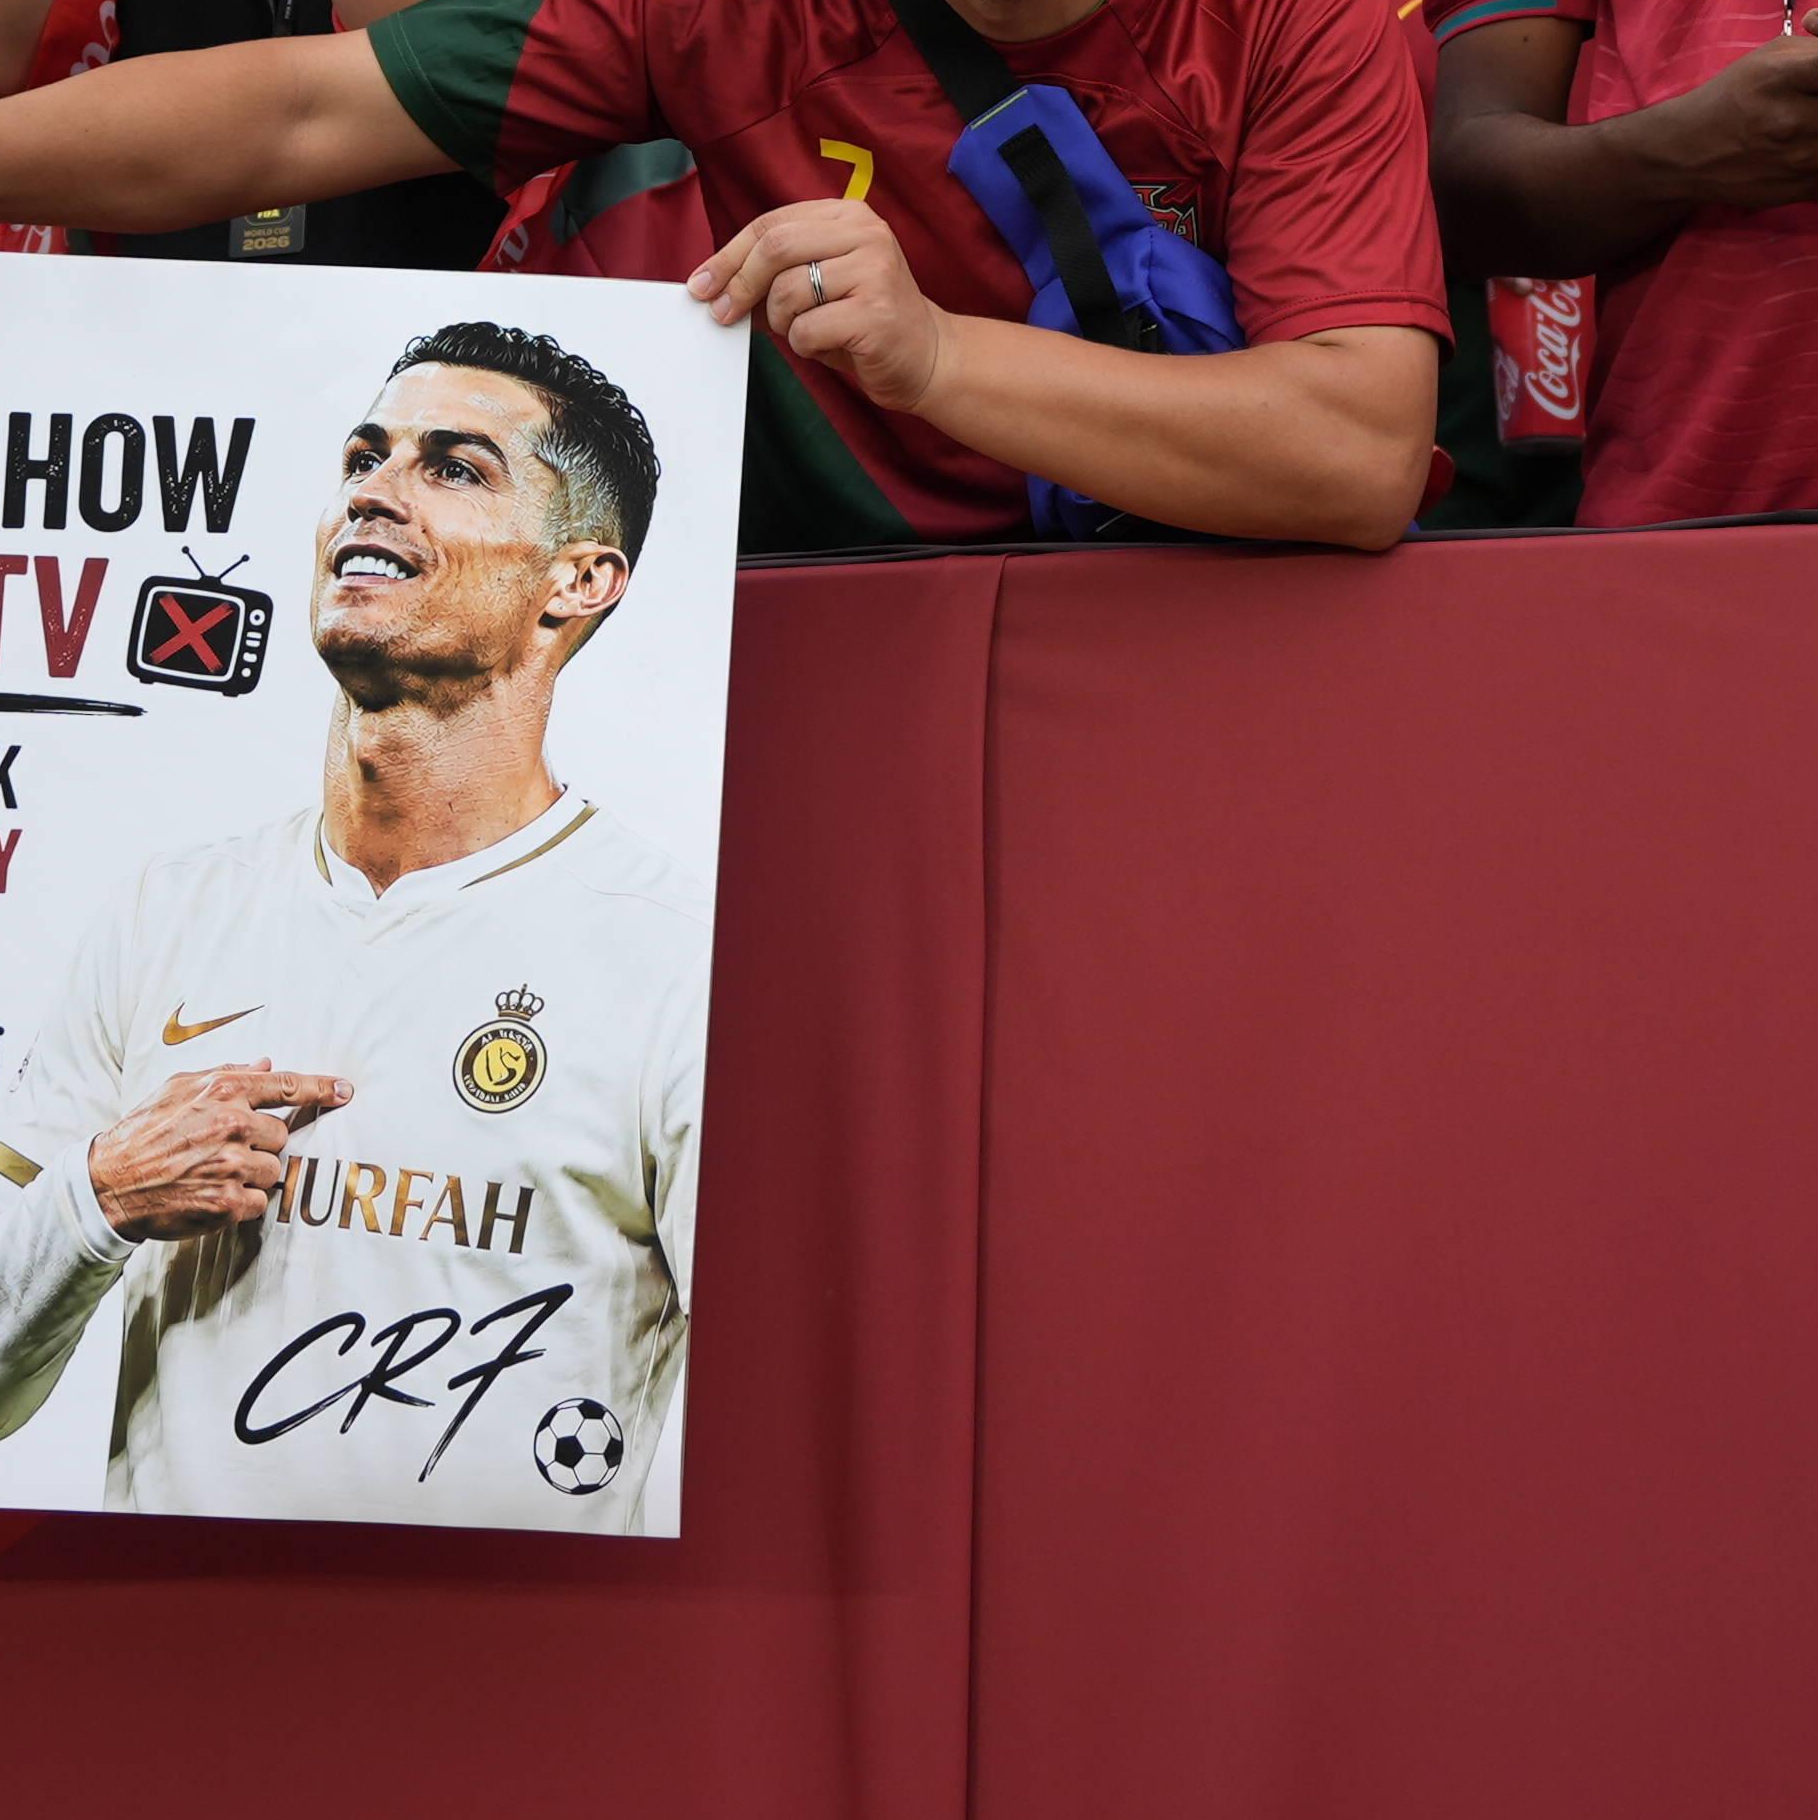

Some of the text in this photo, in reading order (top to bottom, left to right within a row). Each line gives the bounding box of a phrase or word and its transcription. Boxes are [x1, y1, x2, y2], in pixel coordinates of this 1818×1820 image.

[819, 138, 874, 200] 7
[242, 236, 290, 251] 2026
[234, 1283, 574, 1482] CR7
